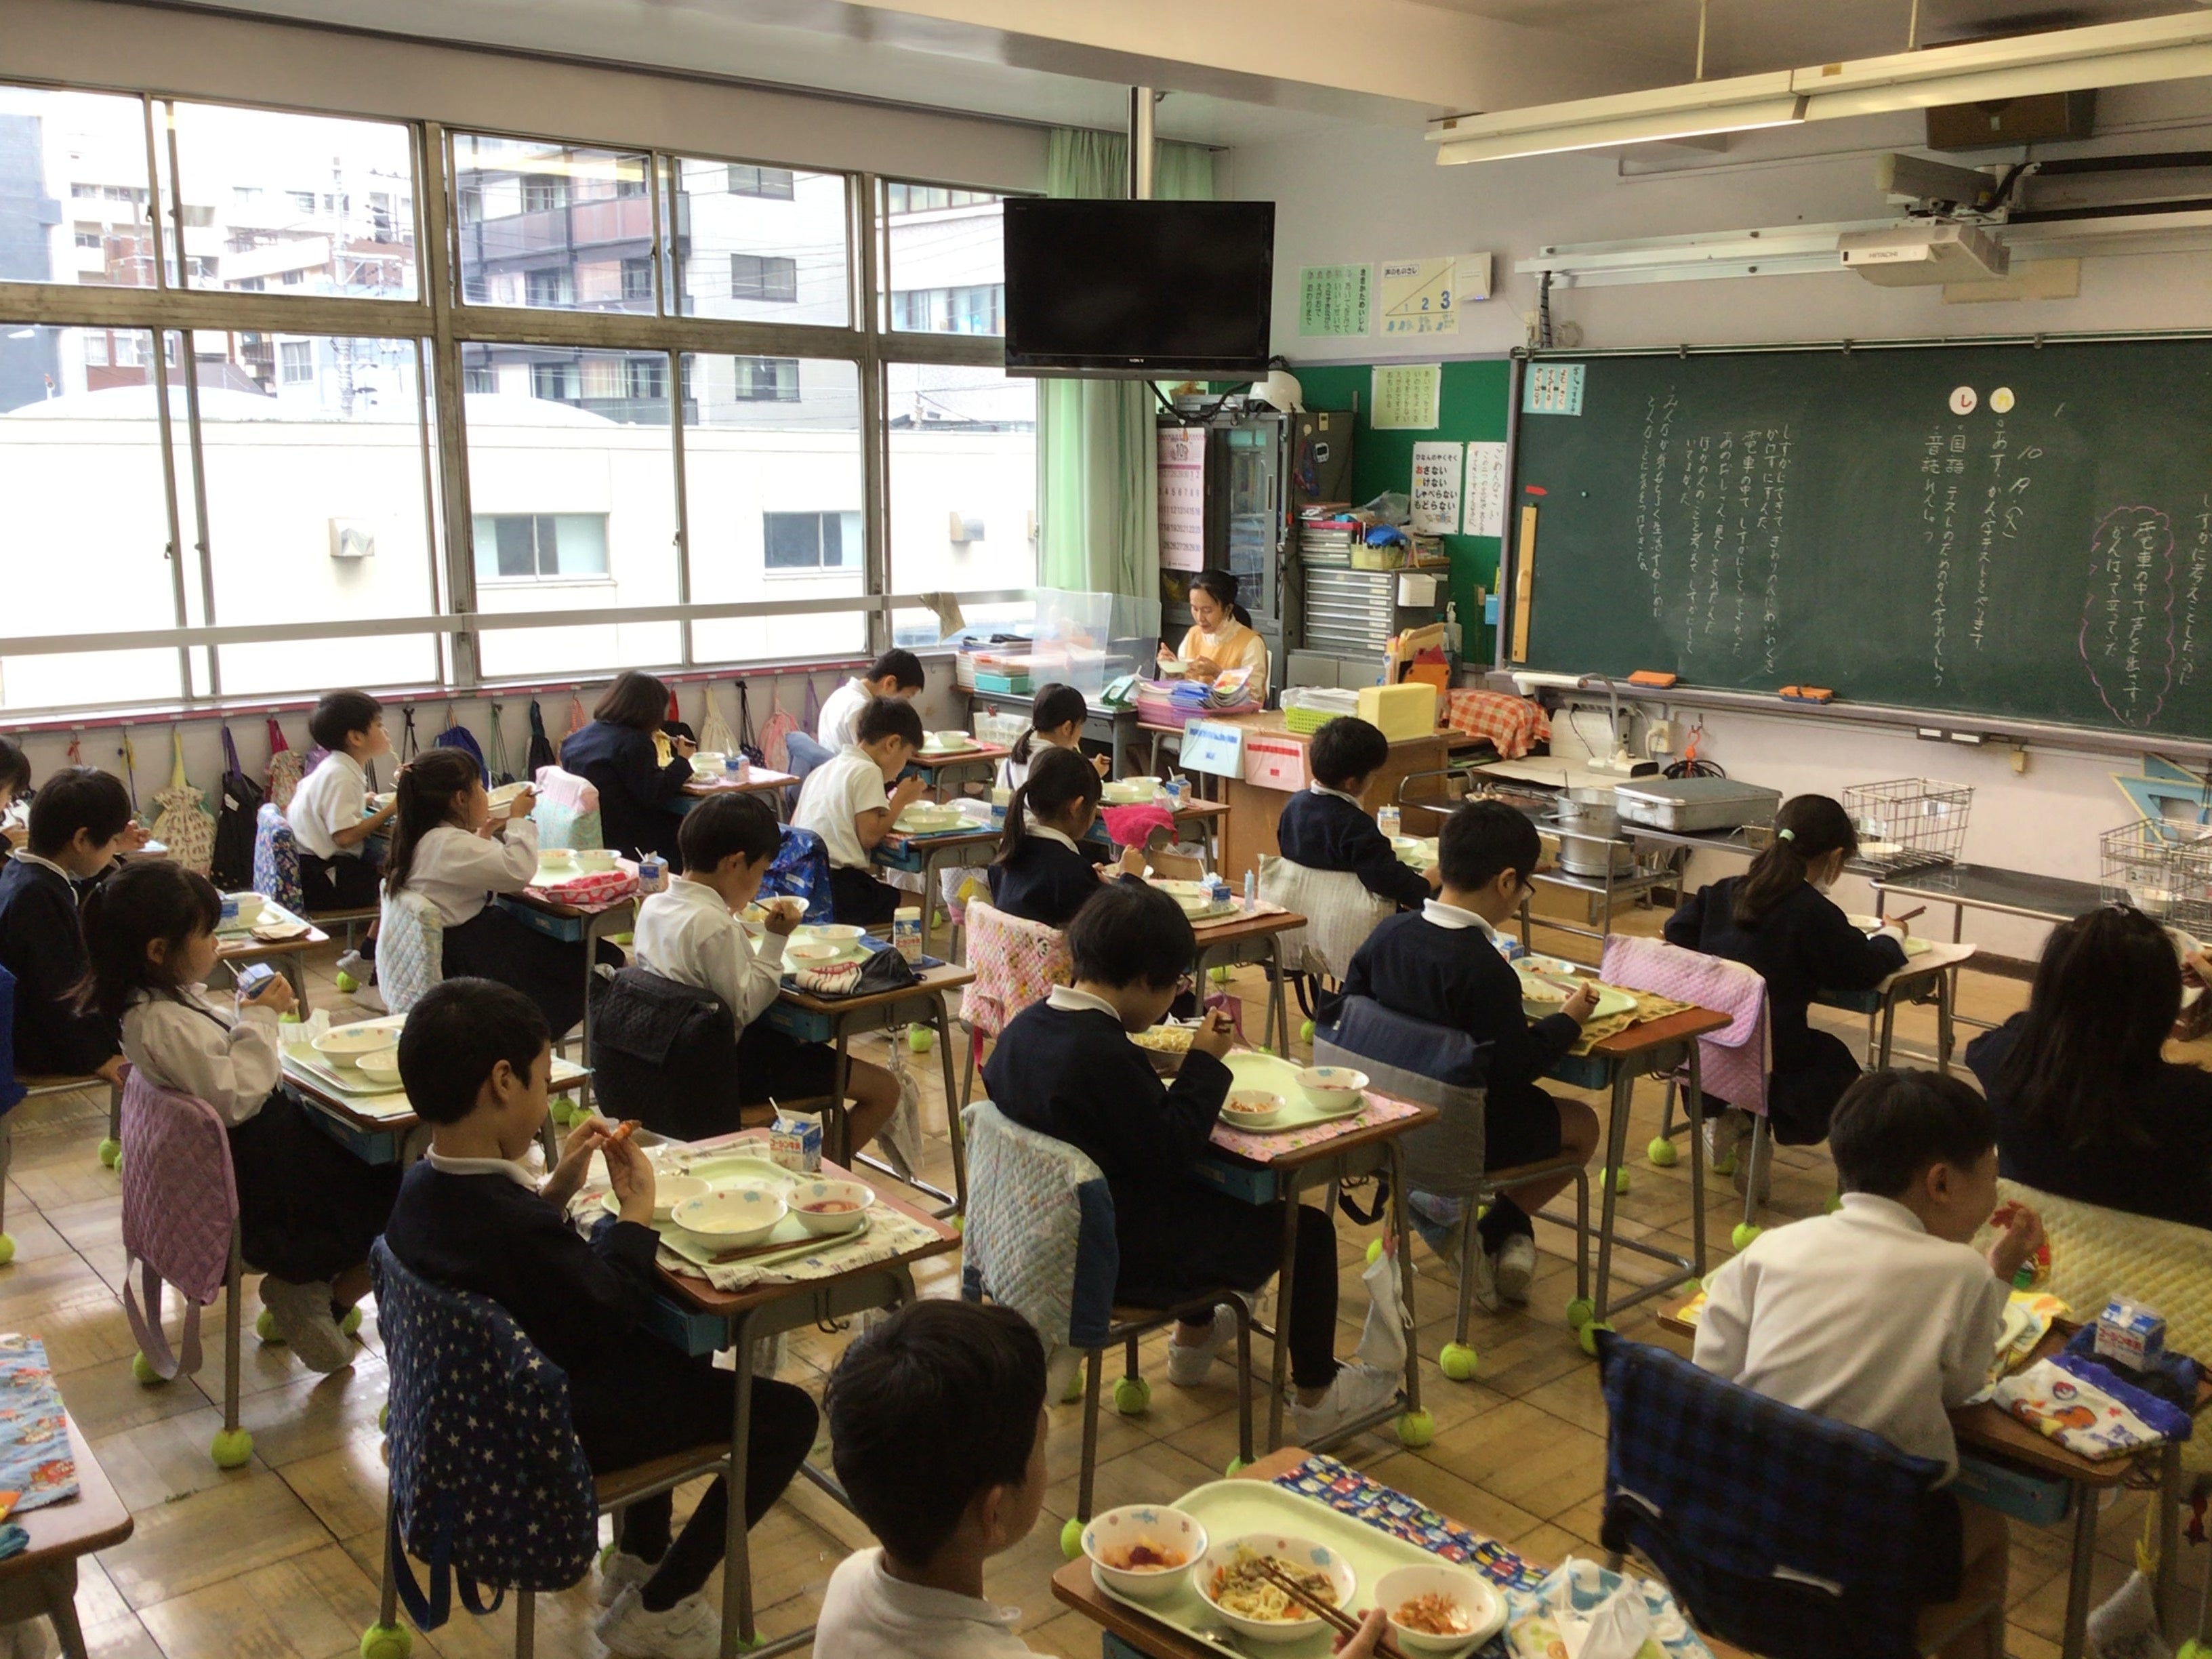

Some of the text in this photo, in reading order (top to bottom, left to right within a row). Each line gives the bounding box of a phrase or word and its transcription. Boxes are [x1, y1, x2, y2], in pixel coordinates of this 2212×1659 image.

[1421, 298, 1429, 310] 2
[1440, 290, 1451, 310] 3
[1961, 394, 1973, 408] し
[1416, 465, 1448, 475] おさない
[1415, 489, 1458, 499] しゃべらない
[1414, 500, 1456, 511] もどらない
